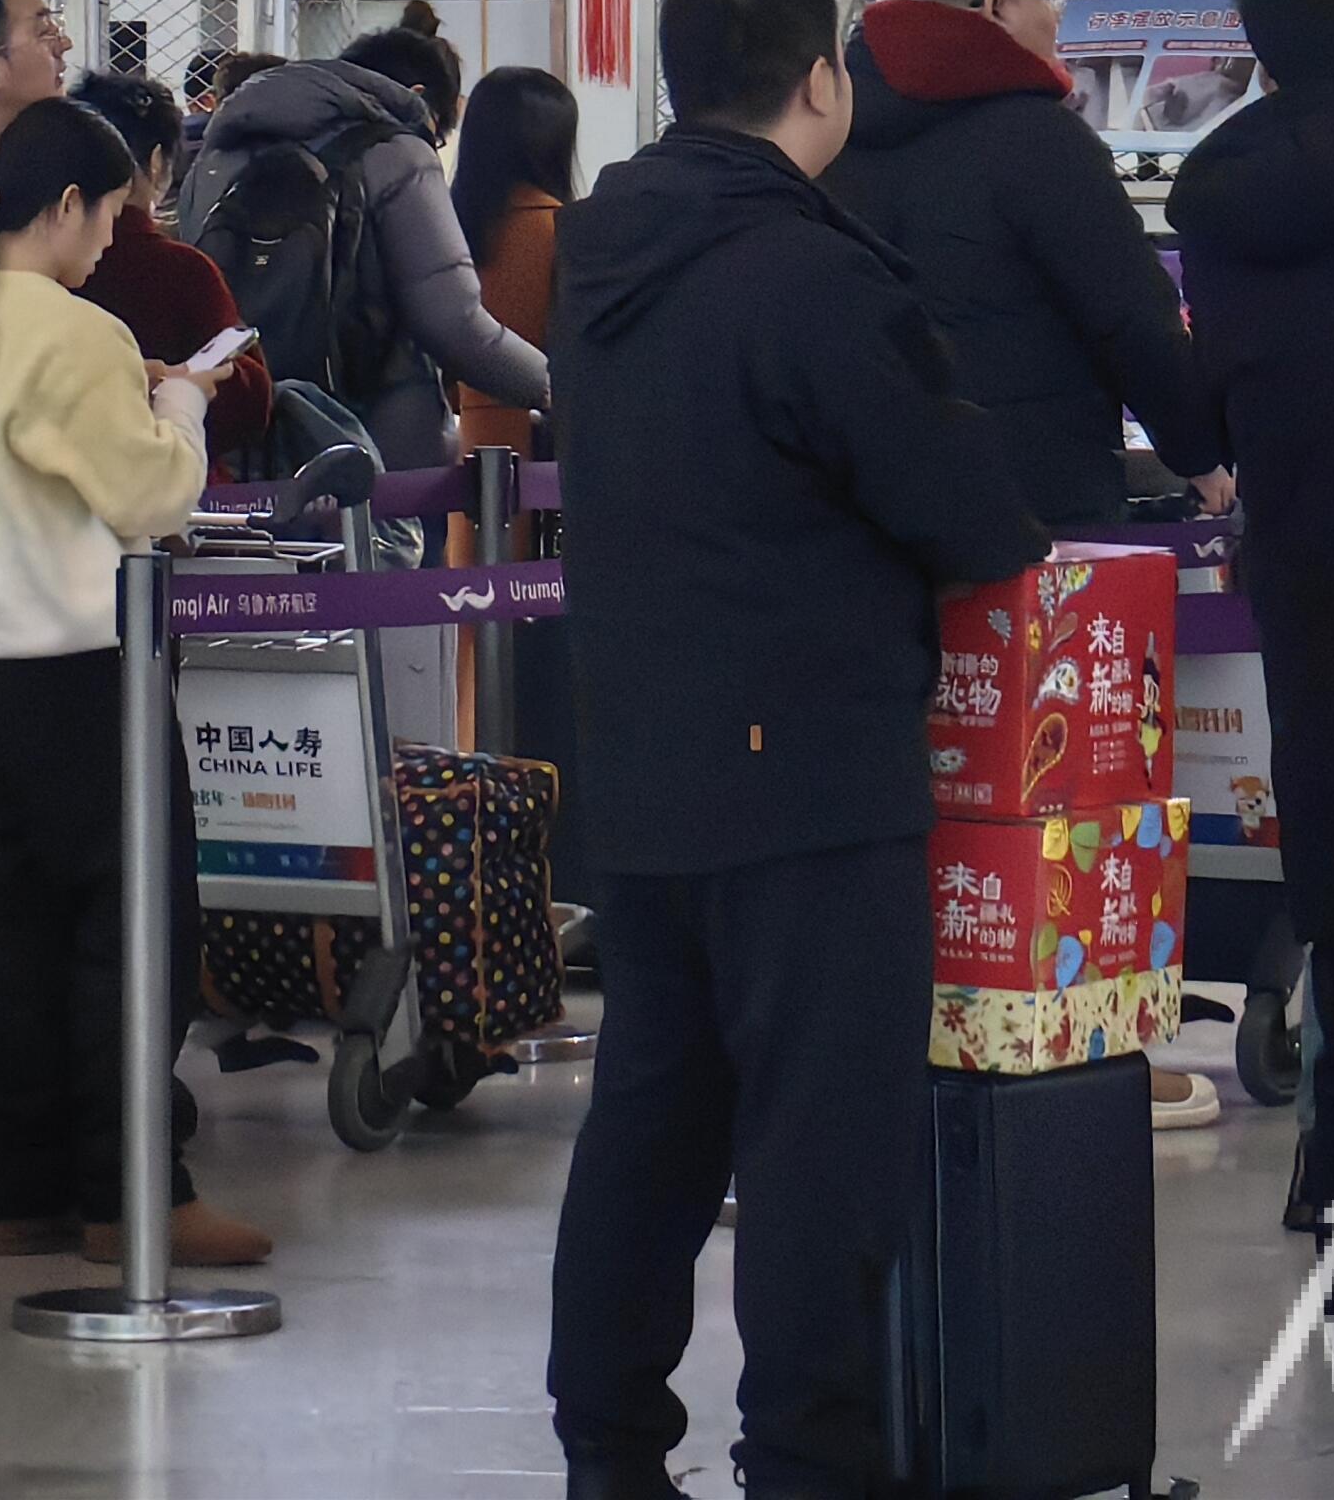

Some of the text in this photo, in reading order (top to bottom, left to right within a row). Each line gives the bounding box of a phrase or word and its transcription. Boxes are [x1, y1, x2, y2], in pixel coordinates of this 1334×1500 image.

[206, 592, 229, 616] Air
[196, 722, 322, 758] 中国人寿
[199, 757, 323, 778] CHINA LIFE
